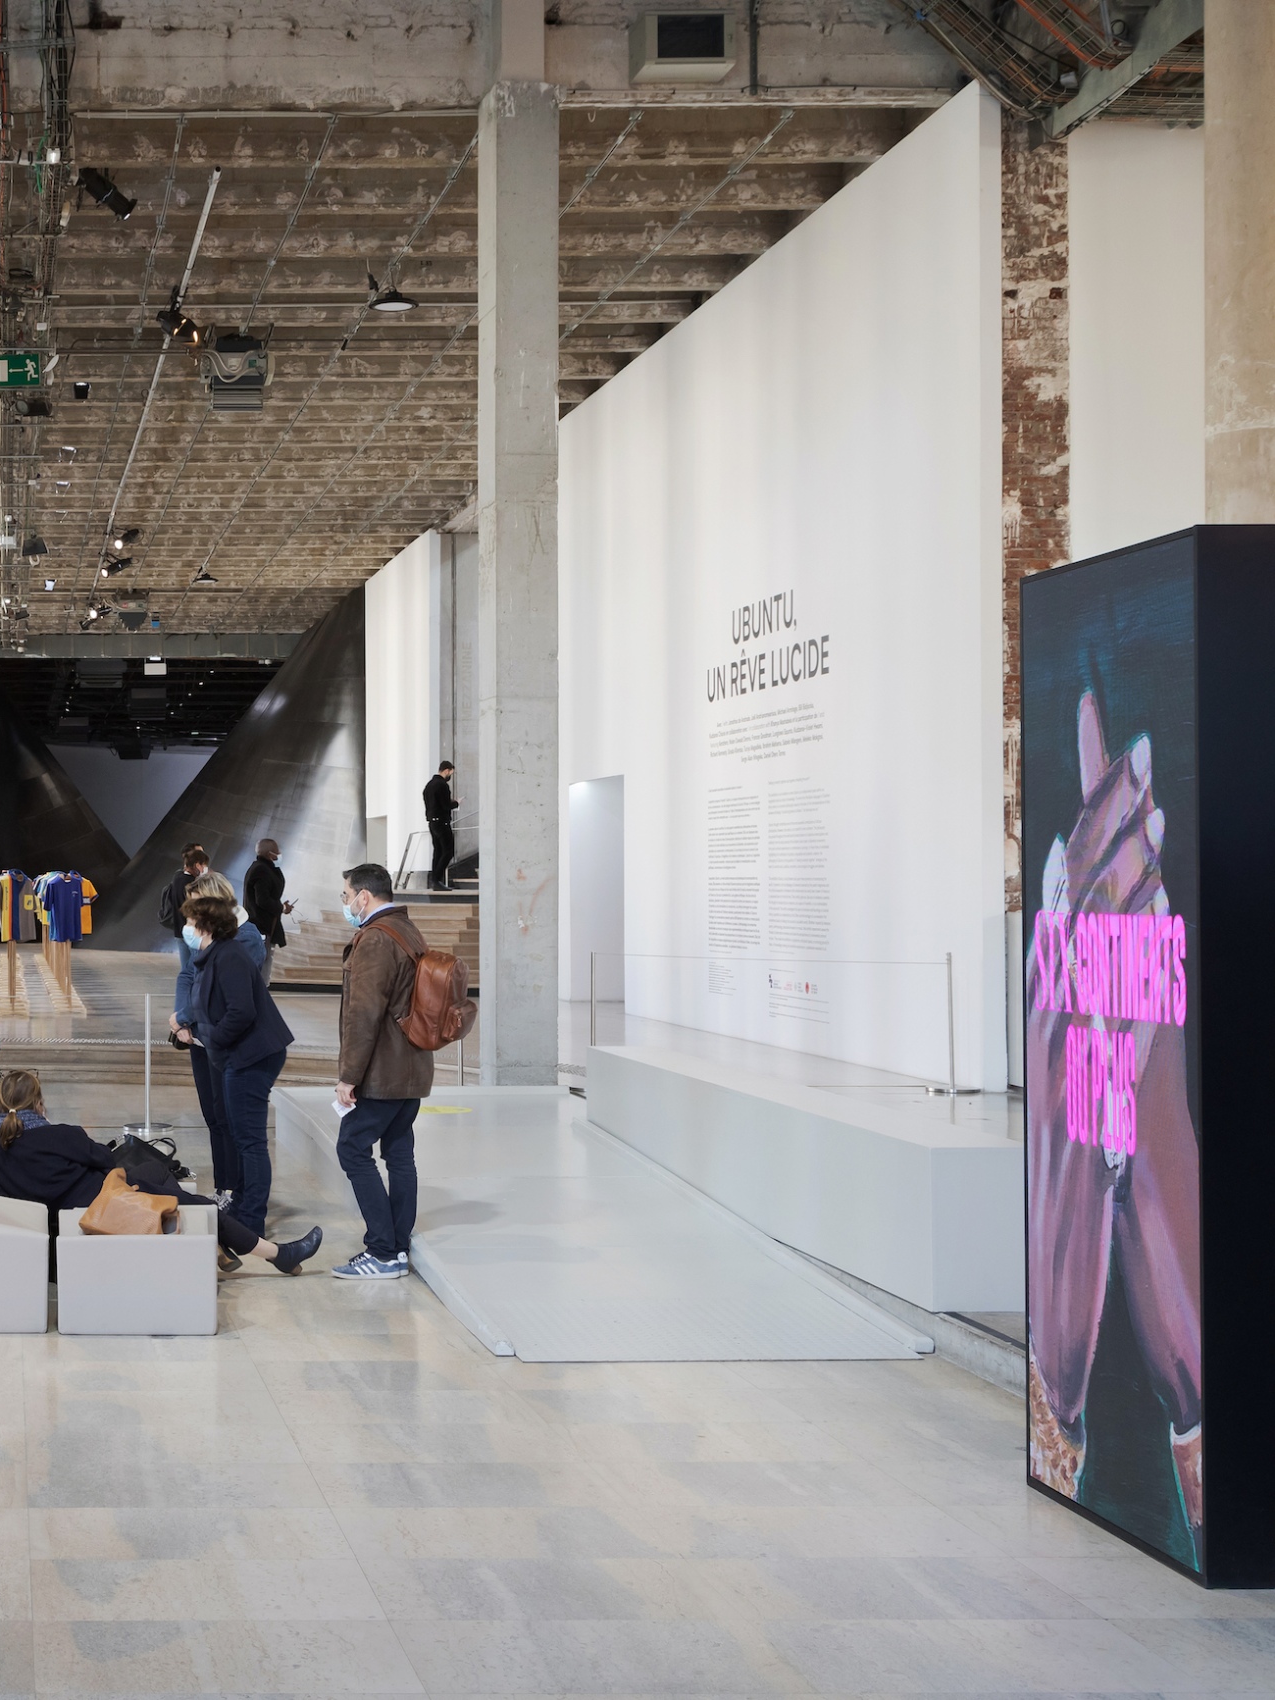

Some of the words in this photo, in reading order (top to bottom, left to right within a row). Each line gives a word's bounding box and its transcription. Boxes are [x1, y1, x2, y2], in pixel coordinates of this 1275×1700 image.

[732, 589, 797, 645] UBUNTU,
[462, 641, 472, 721] MEZZANINE
[707, 664, 726, 703] UN
[730, 648, 766, 698] RÊVE
[771, 634, 830, 687] LUCIDE
[1035, 910, 1074, 1013] SIX
[1075, 912, 1188, 1027] CONTINENTS
[1065, 1024, 1090, 1145] OU
[1091, 1028, 1137, 1156] PLUS
